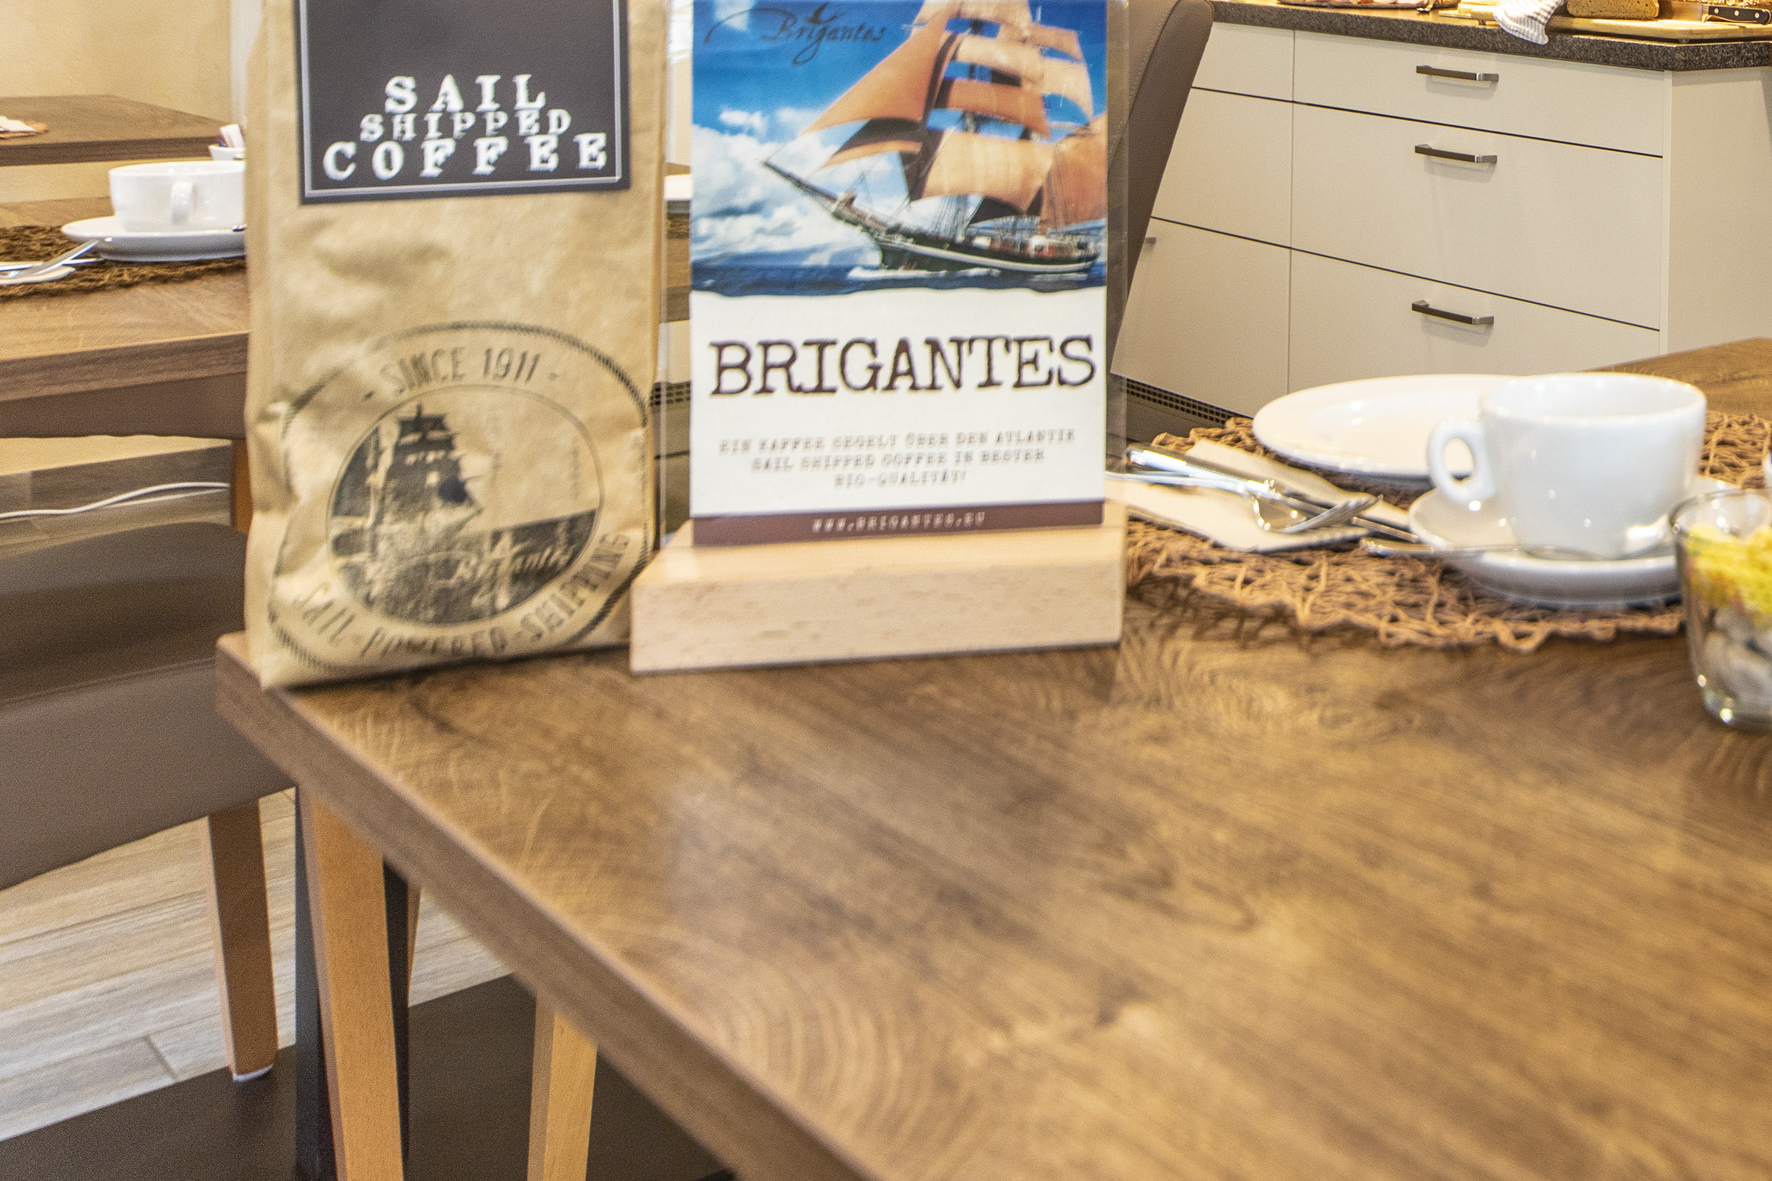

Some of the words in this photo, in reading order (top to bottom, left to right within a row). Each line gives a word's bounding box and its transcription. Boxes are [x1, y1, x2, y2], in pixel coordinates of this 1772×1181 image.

[735, 6, 887, 66] Brigantes
[384, 74, 546, 114] SAIL
[360, 108, 571, 142] SHIPPED
[323, 132, 607, 181] COFFEE
[380, 347, 465, 396] SINCE
[483, 347, 541, 384] 1911
[709, 335, 1097, 397] BRIGANTES
[719, 439, 752, 454] EIN
[758, 436, 825, 453] KAFFEE
[832, 433, 897, 450] SEGELT
[905, 430, 949, 448] ÜBER
[955, 430, 988, 446] DEN
[996, 428, 1075, 444] ATLANTIK
[752, 457, 794, 472] SAIL
[800, 454, 875, 470] SHIPPED
[881, 451, 947, 467] COFFEE
[955, 450, 973, 465] IN
[981, 448, 1045, 463] BESTER
